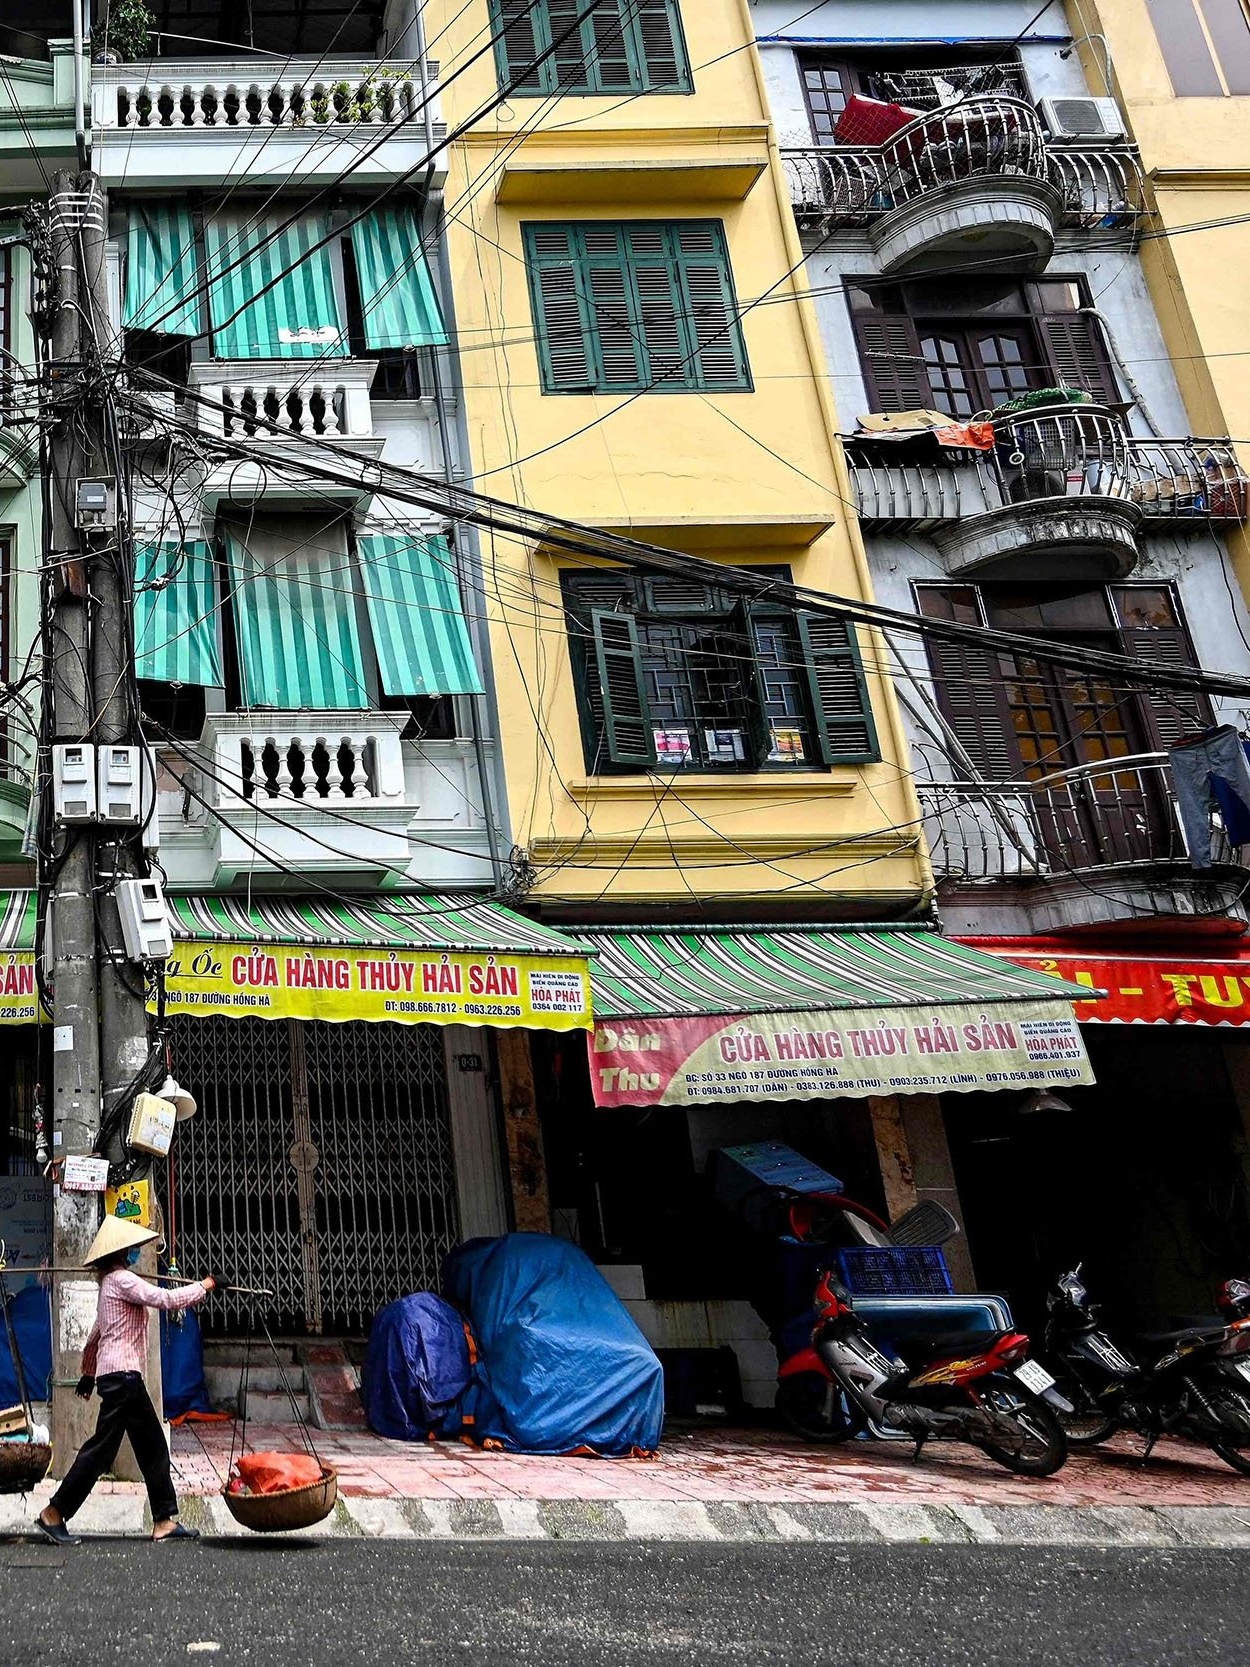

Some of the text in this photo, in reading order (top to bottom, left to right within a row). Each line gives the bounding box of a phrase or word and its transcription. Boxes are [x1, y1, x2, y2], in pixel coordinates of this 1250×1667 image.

[232, 946, 518, 996] CỬA HÀNG THỦY HẢI SẢN
[185, 992, 199, 1004] 187
[202, 992, 231, 1005] ĐƯỜNG
[259, 994, 270, 1006] HÀ
[531, 986, 581, 1003] HÒA PHÁT
[385, 1000, 398, 1011] ĐT:
[400, 1001, 457, 1013] 098.666.7812
[464, 1003, 521, 1016] 0963.226.256
[569, 1004, 582, 1012] 117
[720, 1014, 1018, 1064] CỬA HÀNG THỦY HẢI SẢN
[1025, 1035, 1078, 1051] HÒA PHÁT
[601, 1067, 660, 1093] Thu
[686, 1074, 699, 1083] ĐC:
[715, 1072, 726, 1081] 33
[750, 1070, 764, 1080] 187
[826, 1066, 838, 1076] HÀ
[687, 1087, 701, 1096] ĐT:
[702, 1085, 759, 1096] 0984.681.707
[796, 1079, 854, 1092] 0383.126.888
[856, 1078, 881, 1089] (THU)
[889, 1075, 947, 1087] 0903.235.712
[985, 1071, 1045, 1082] 0976.056.988
[1047, 1068, 1081, 1080] (THIỆU)
